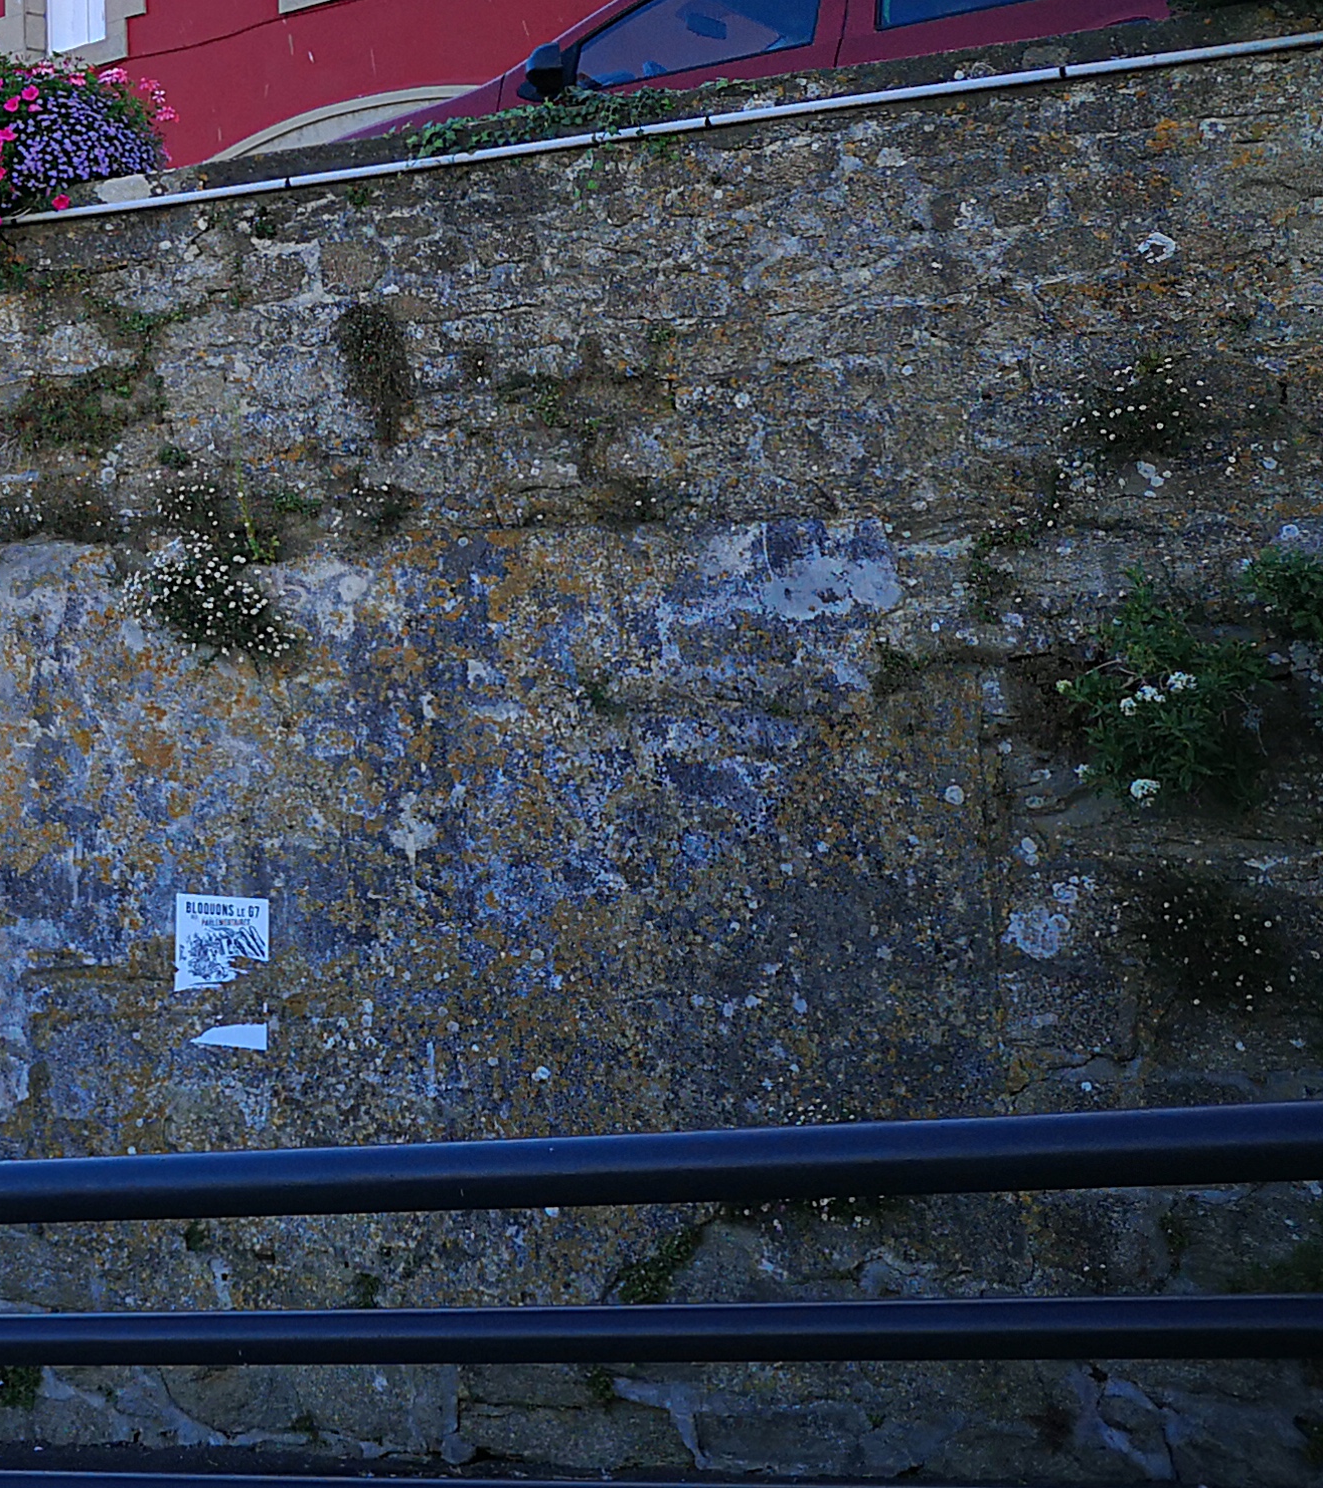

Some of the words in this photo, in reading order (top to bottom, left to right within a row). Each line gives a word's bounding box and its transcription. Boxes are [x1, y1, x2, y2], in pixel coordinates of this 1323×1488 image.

[186, 901, 234, 917] BLOQUONS
[237, 908, 245, 917] LE
[248, 905, 260, 918] G7
